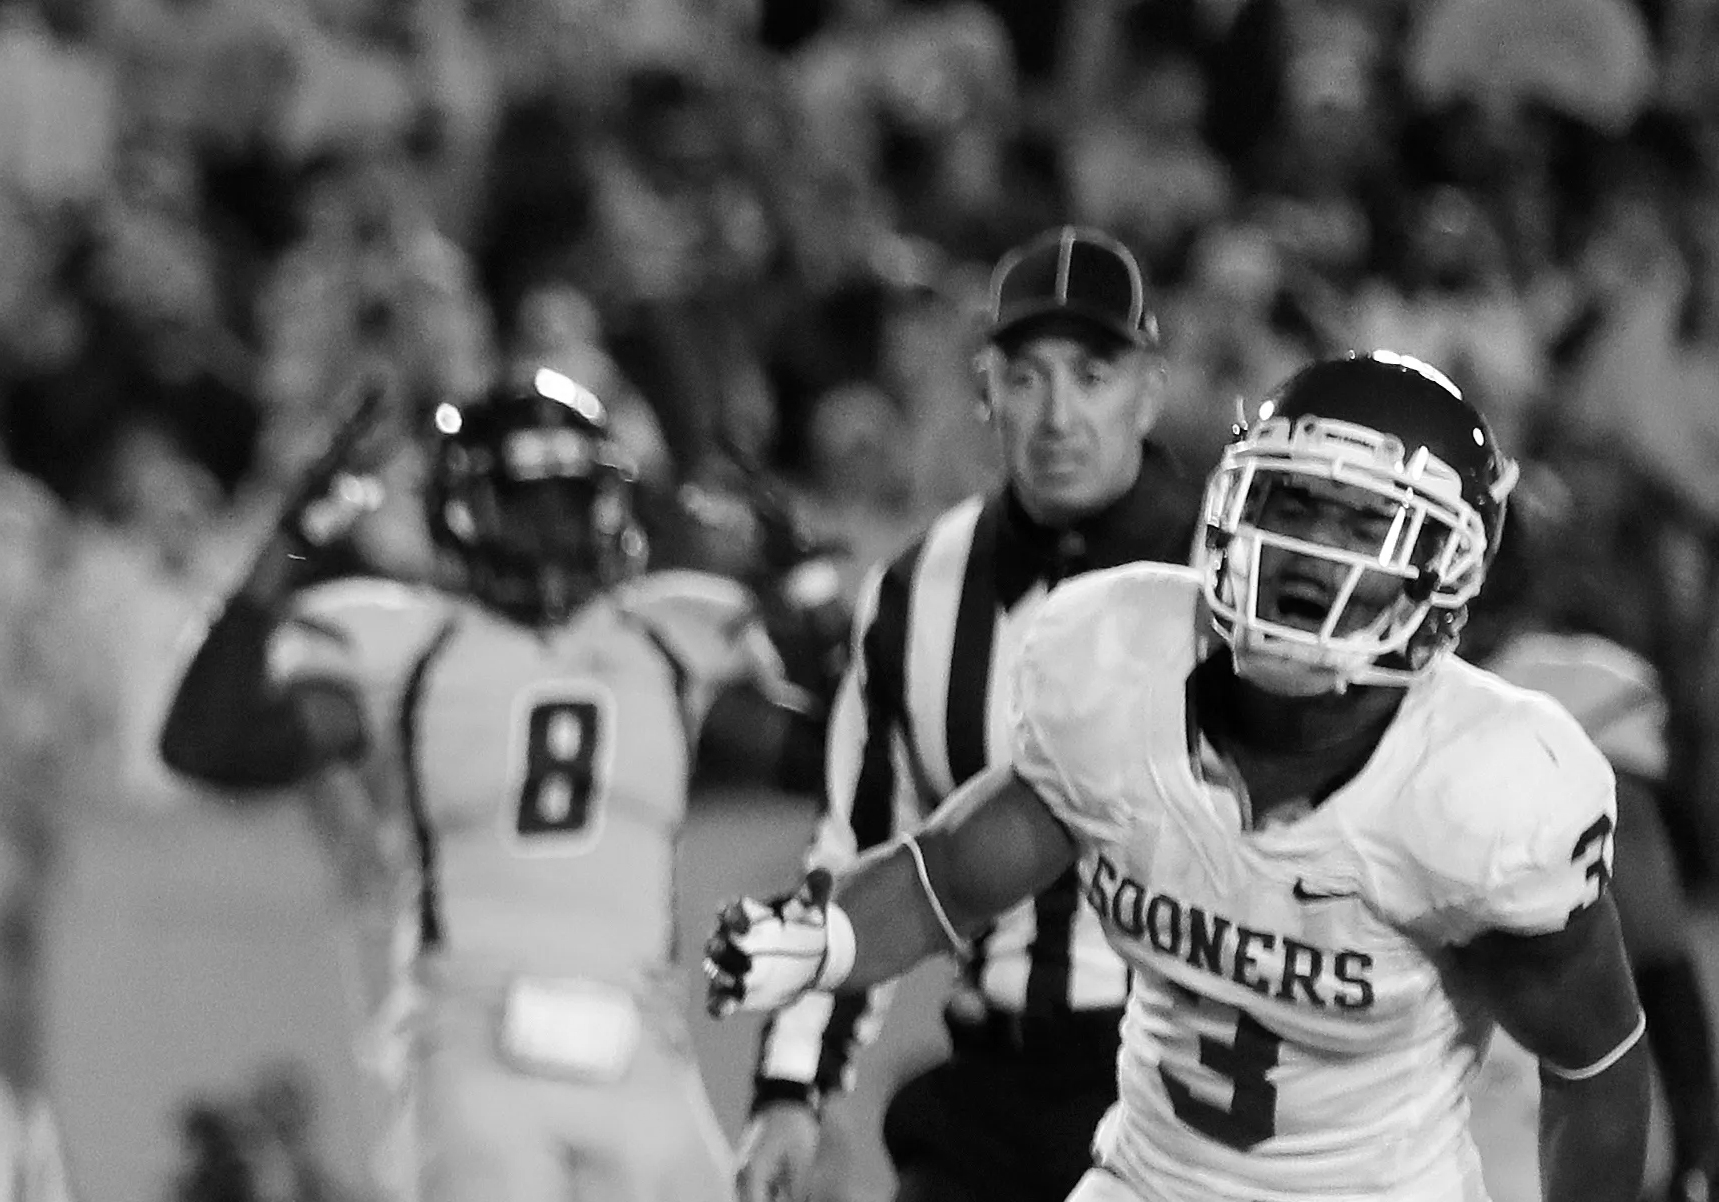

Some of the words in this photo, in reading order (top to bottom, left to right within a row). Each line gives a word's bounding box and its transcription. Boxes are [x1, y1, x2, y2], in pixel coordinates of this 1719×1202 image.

[512, 697, 604, 841] 8
[1087, 854, 1376, 1009] SOONERS
[1157, 985, 1280, 1153] 3
